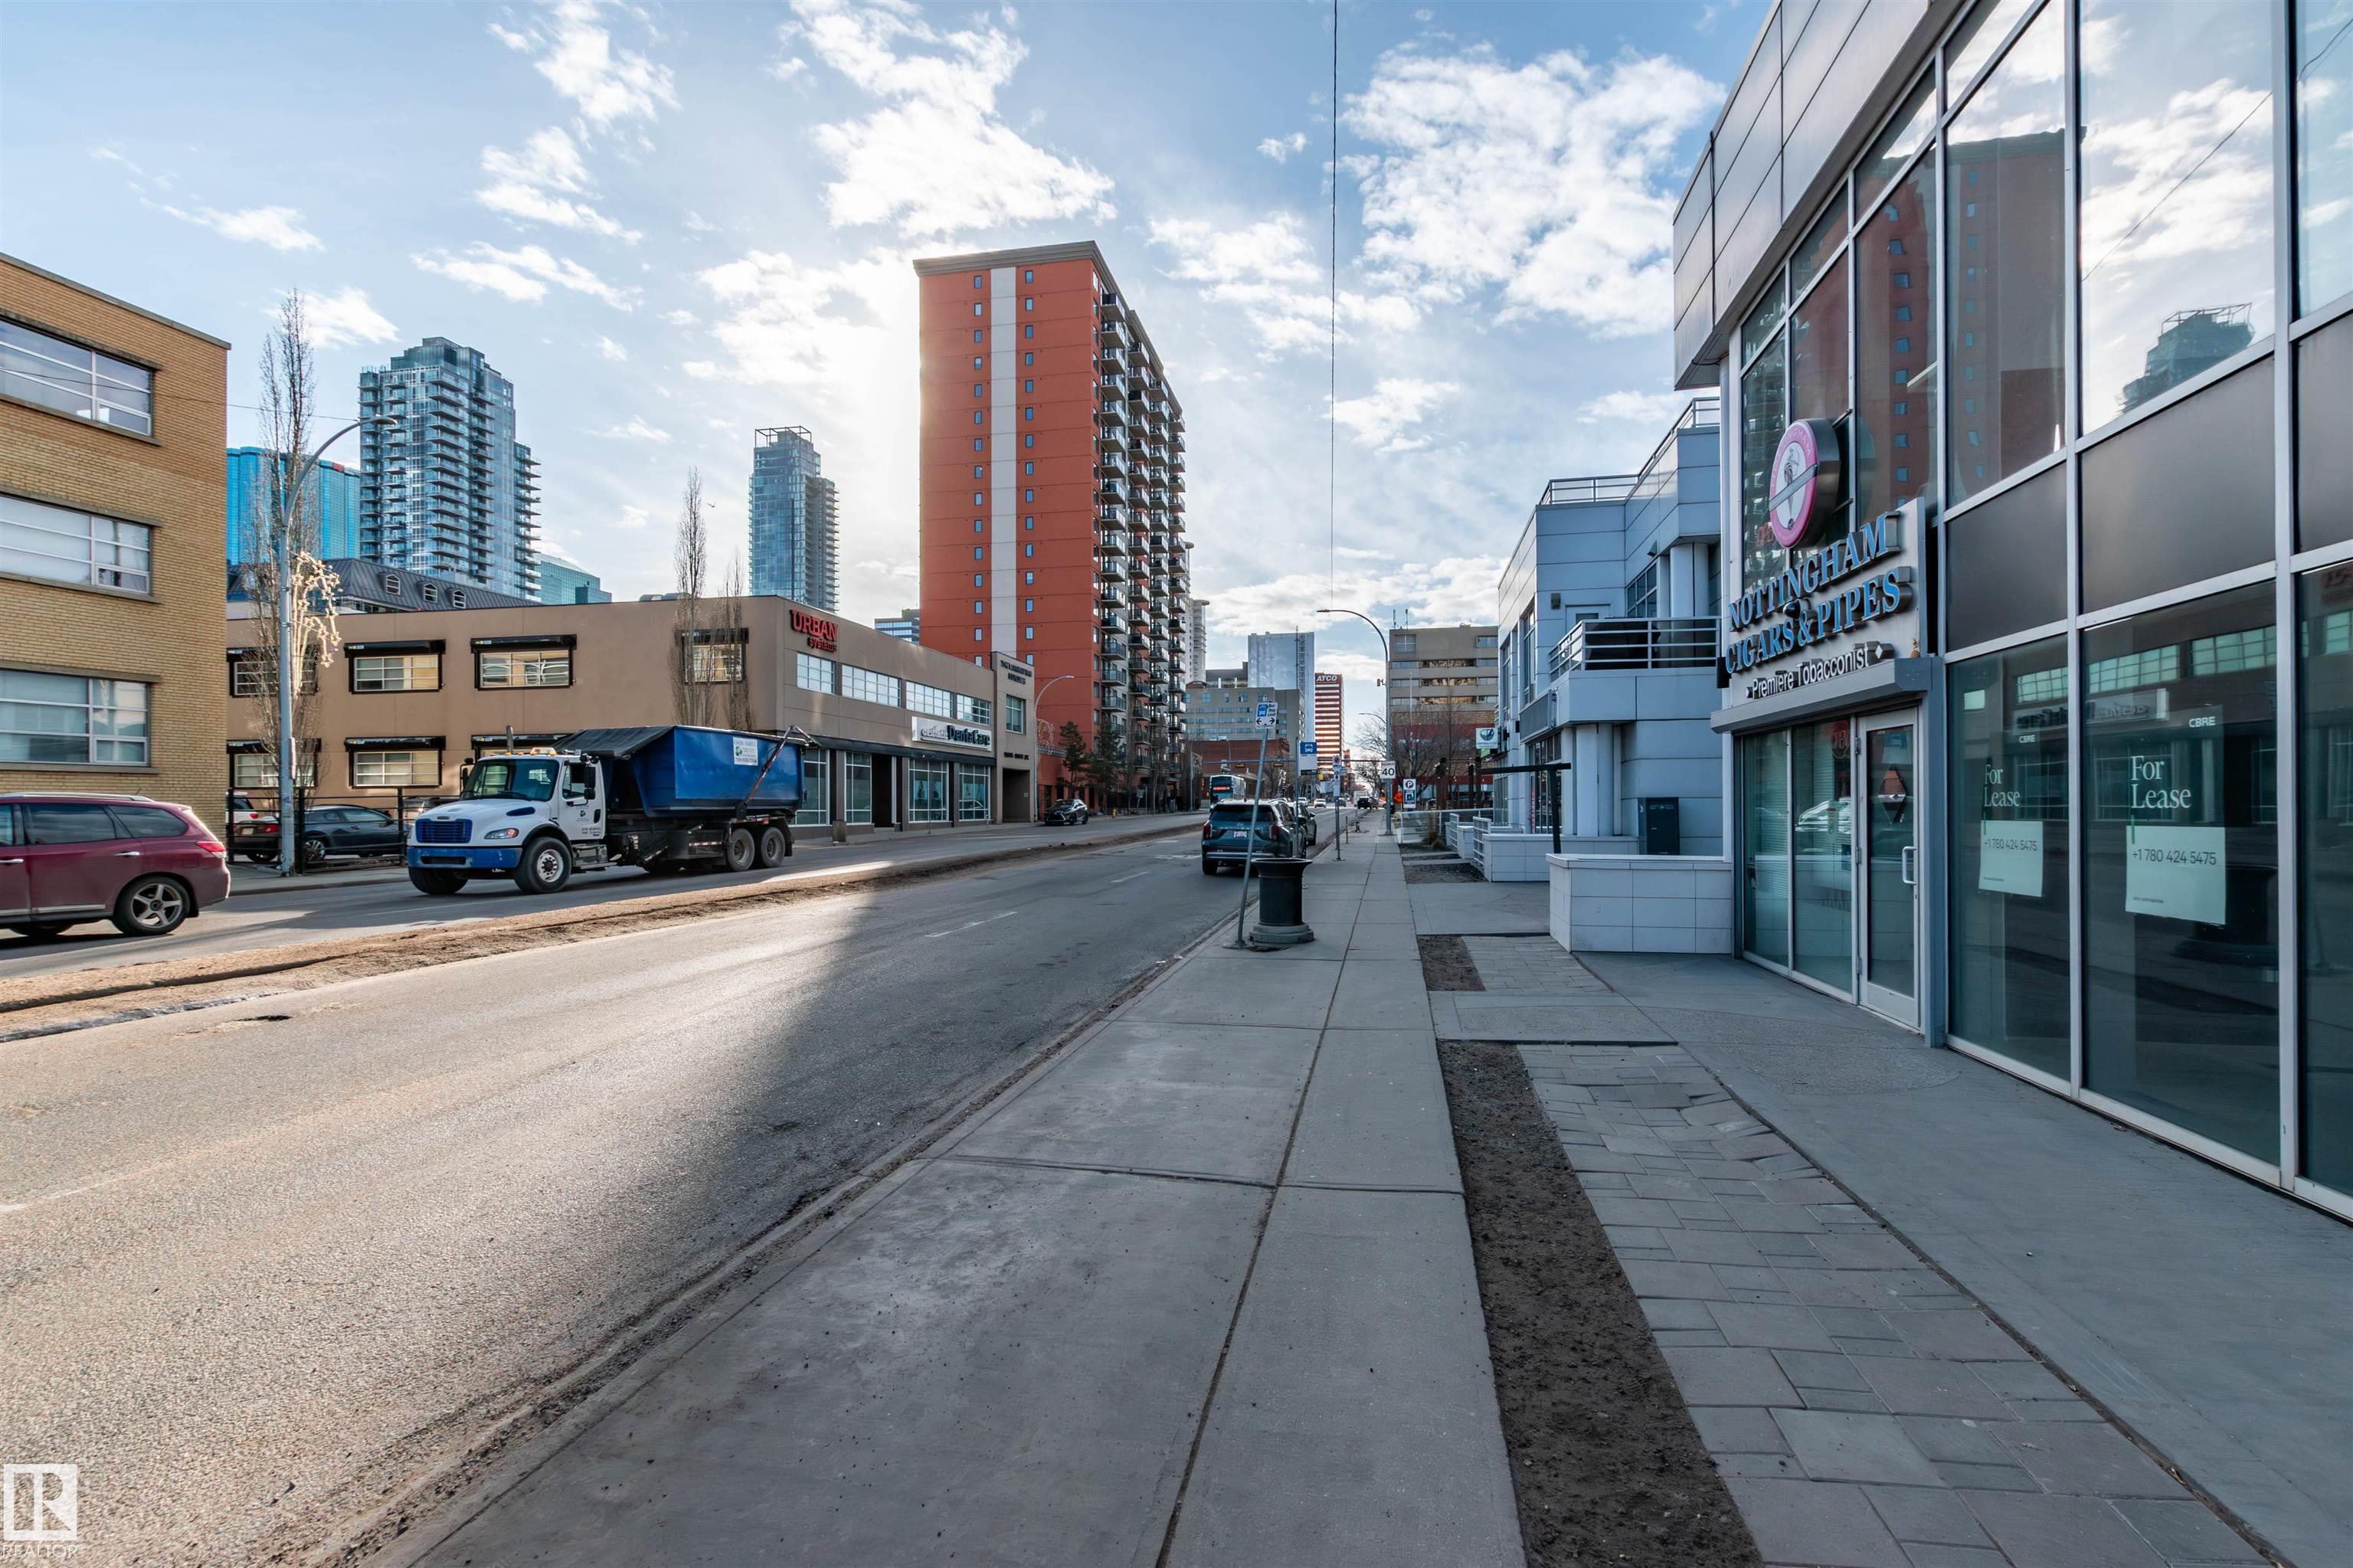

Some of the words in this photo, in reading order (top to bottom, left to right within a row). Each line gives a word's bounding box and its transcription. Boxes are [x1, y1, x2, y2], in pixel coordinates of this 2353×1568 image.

[1729, 513, 1889, 631] NOTTINGHAM
[790, 610, 839, 641] URBAN
[1752, 670, 1794, 699] Premiere
[1796, 646, 1870, 687] Tobacconist
[2188, 716, 2216, 728] CBRE
[1382, 768, 1395, 776] 40
[1985, 764, 2004, 784] For
[2130, 755, 2165, 781] For
[1984, 787, 2021, 807] Lease
[2131, 784, 2192, 809] Lease
[1991, 839, 2004, 849] 780
[2006, 840, 2019, 850] 424
[2020, 840, 2037, 851] 5475
[2132, 849, 2142, 860] +1
[2144, 849, 2164, 862] 780
[2166, 850, 2188, 863] 424
[2190, 852, 2217, 866] 5475
